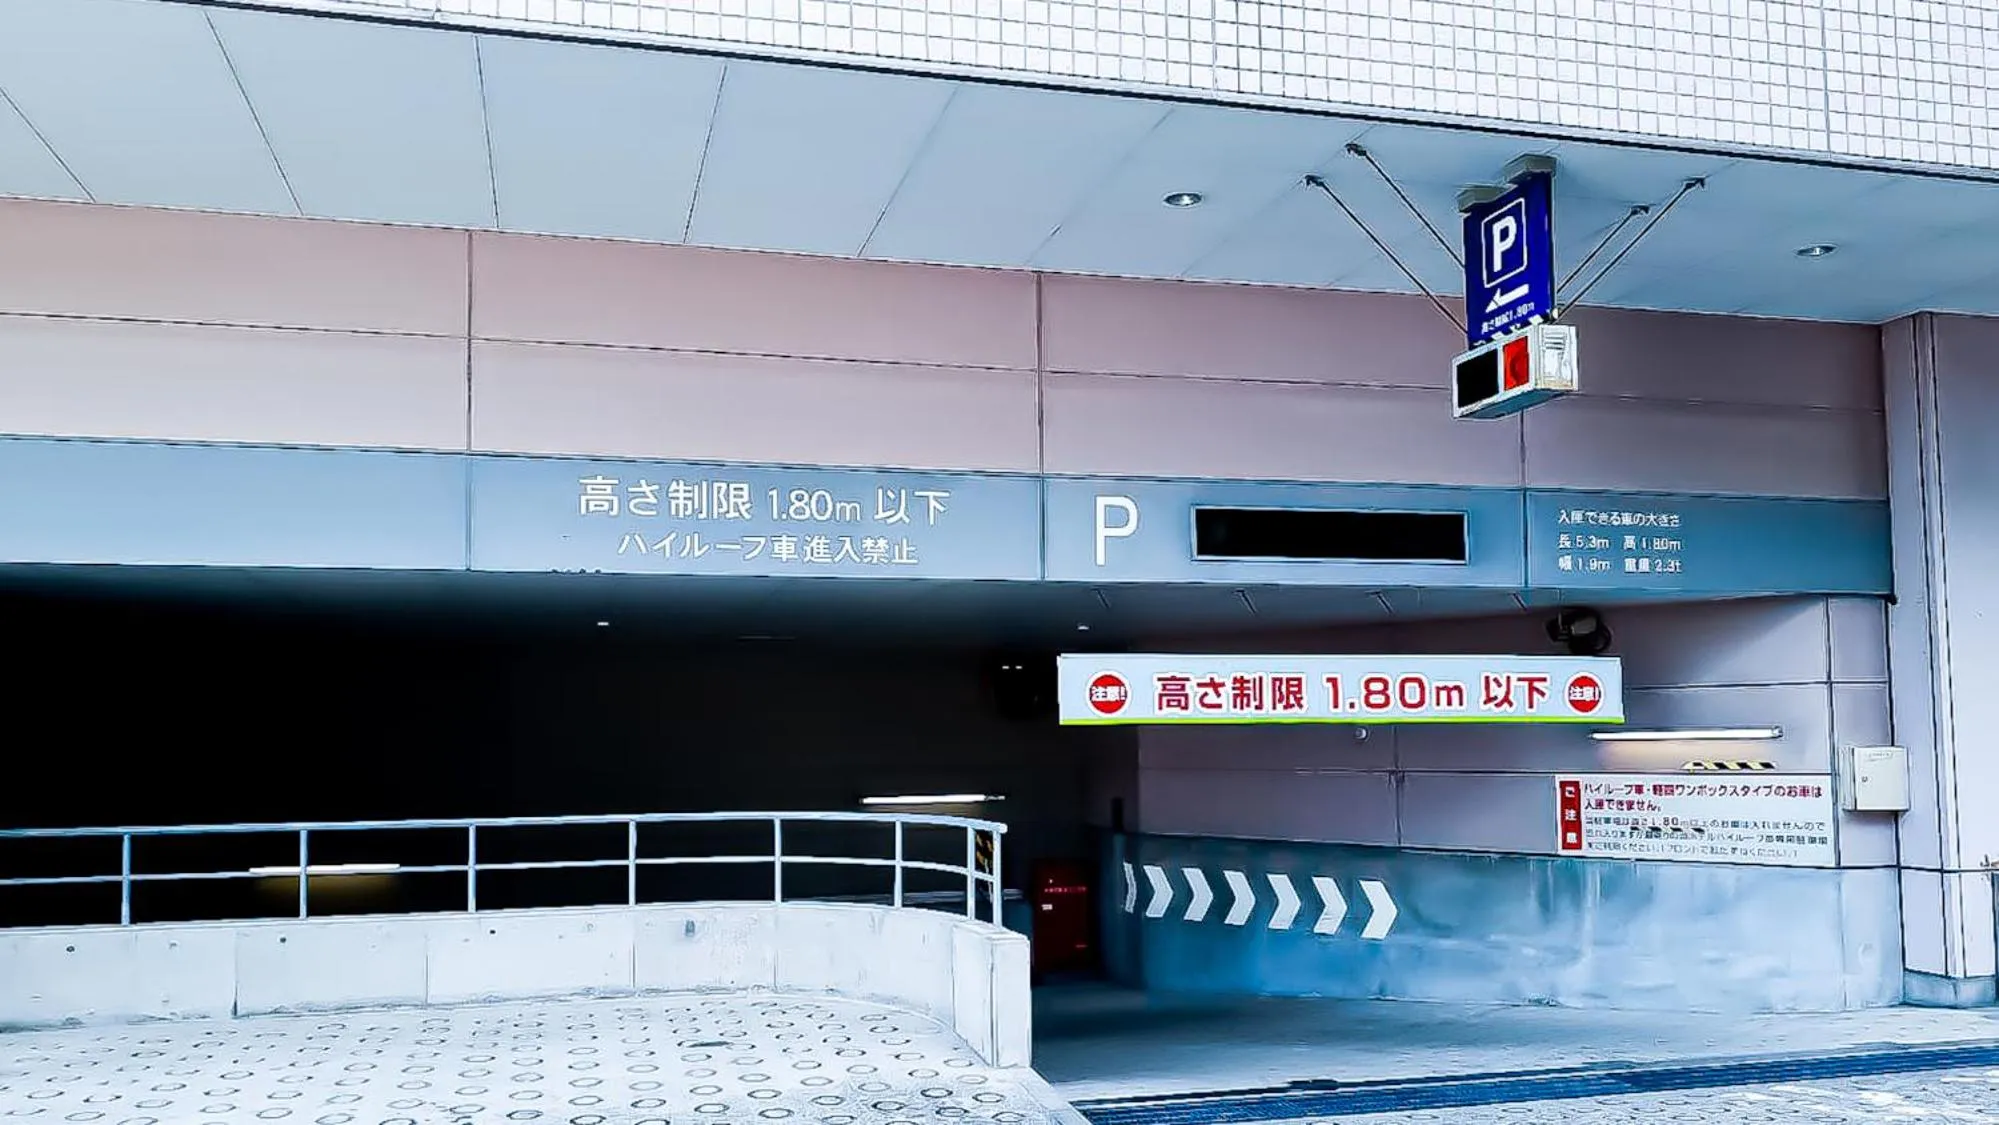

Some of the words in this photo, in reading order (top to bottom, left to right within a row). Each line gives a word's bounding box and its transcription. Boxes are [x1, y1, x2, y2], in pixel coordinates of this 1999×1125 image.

[1492, 215, 1517, 273] P
[578, 475, 753, 520] 高さ制限
[768, 488, 862, 522] 1.80m
[873, 488, 951, 526] 以下
[617, 532, 919, 564] ハイルーフ車進入禁止
[1095, 495, 1139, 566] P
[1157, 675, 1305, 711] 高さ制限
[1326, 677, 1465, 710] 1.80m
[1483, 675, 1548, 709] 以下
